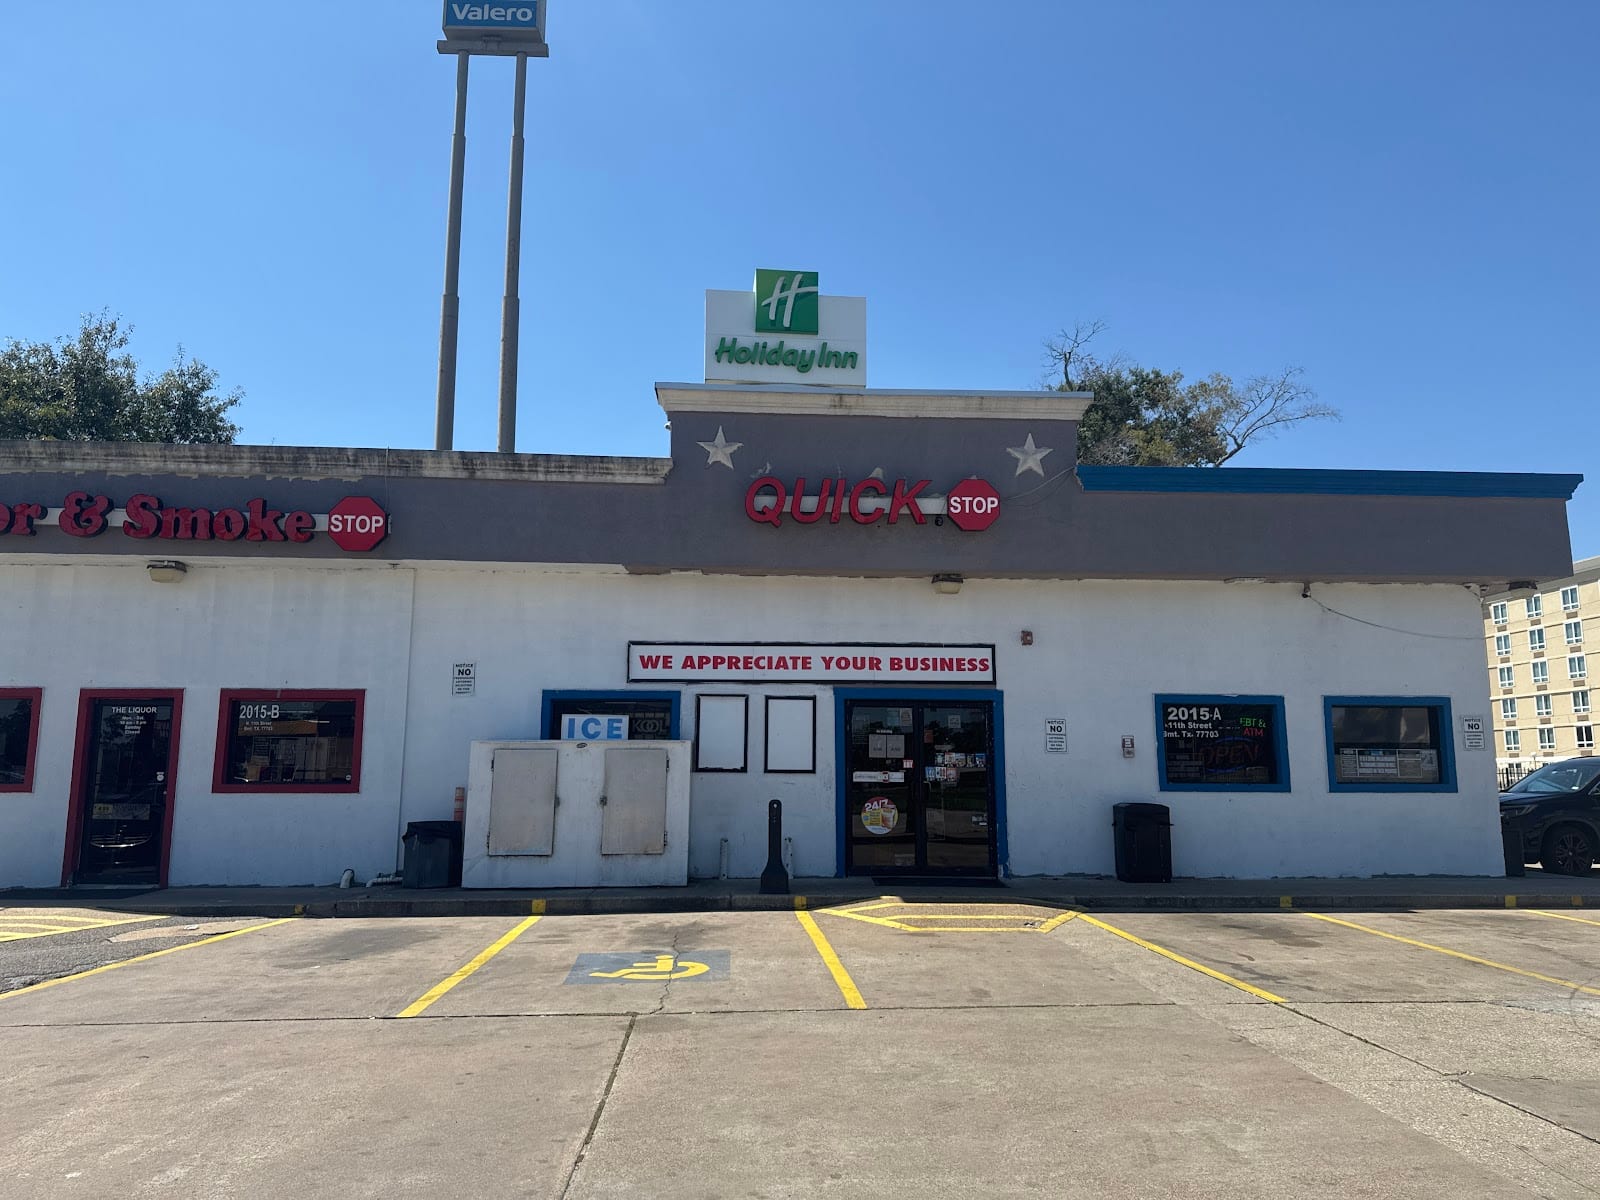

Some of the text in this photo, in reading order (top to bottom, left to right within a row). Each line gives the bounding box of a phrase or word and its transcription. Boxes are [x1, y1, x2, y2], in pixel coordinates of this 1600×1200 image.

[452, 3, 533, 21] Valero
[715, 337, 858, 373] Holiday Inn
[745, 476, 932, 528] QUICK
[950, 497, 999, 514] STOP
[59, 491, 111, 537] &
[123, 494, 316, 542] Smoke
[330, 514, 384, 533] STOP
[457, 668, 472, 676] NO
[639, 655, 990, 672] WE APPRECIATE YOUR BUSINESS
[239, 704, 280, 719] 2015-B
[568, 717, 623, 739] ICE
[632, 719, 669, 735] KOOL
[1240, 717, 1266, 728] EBT &
[1243, 728, 1264, 737] ATM
[864, 798, 889, 811] 24/7
